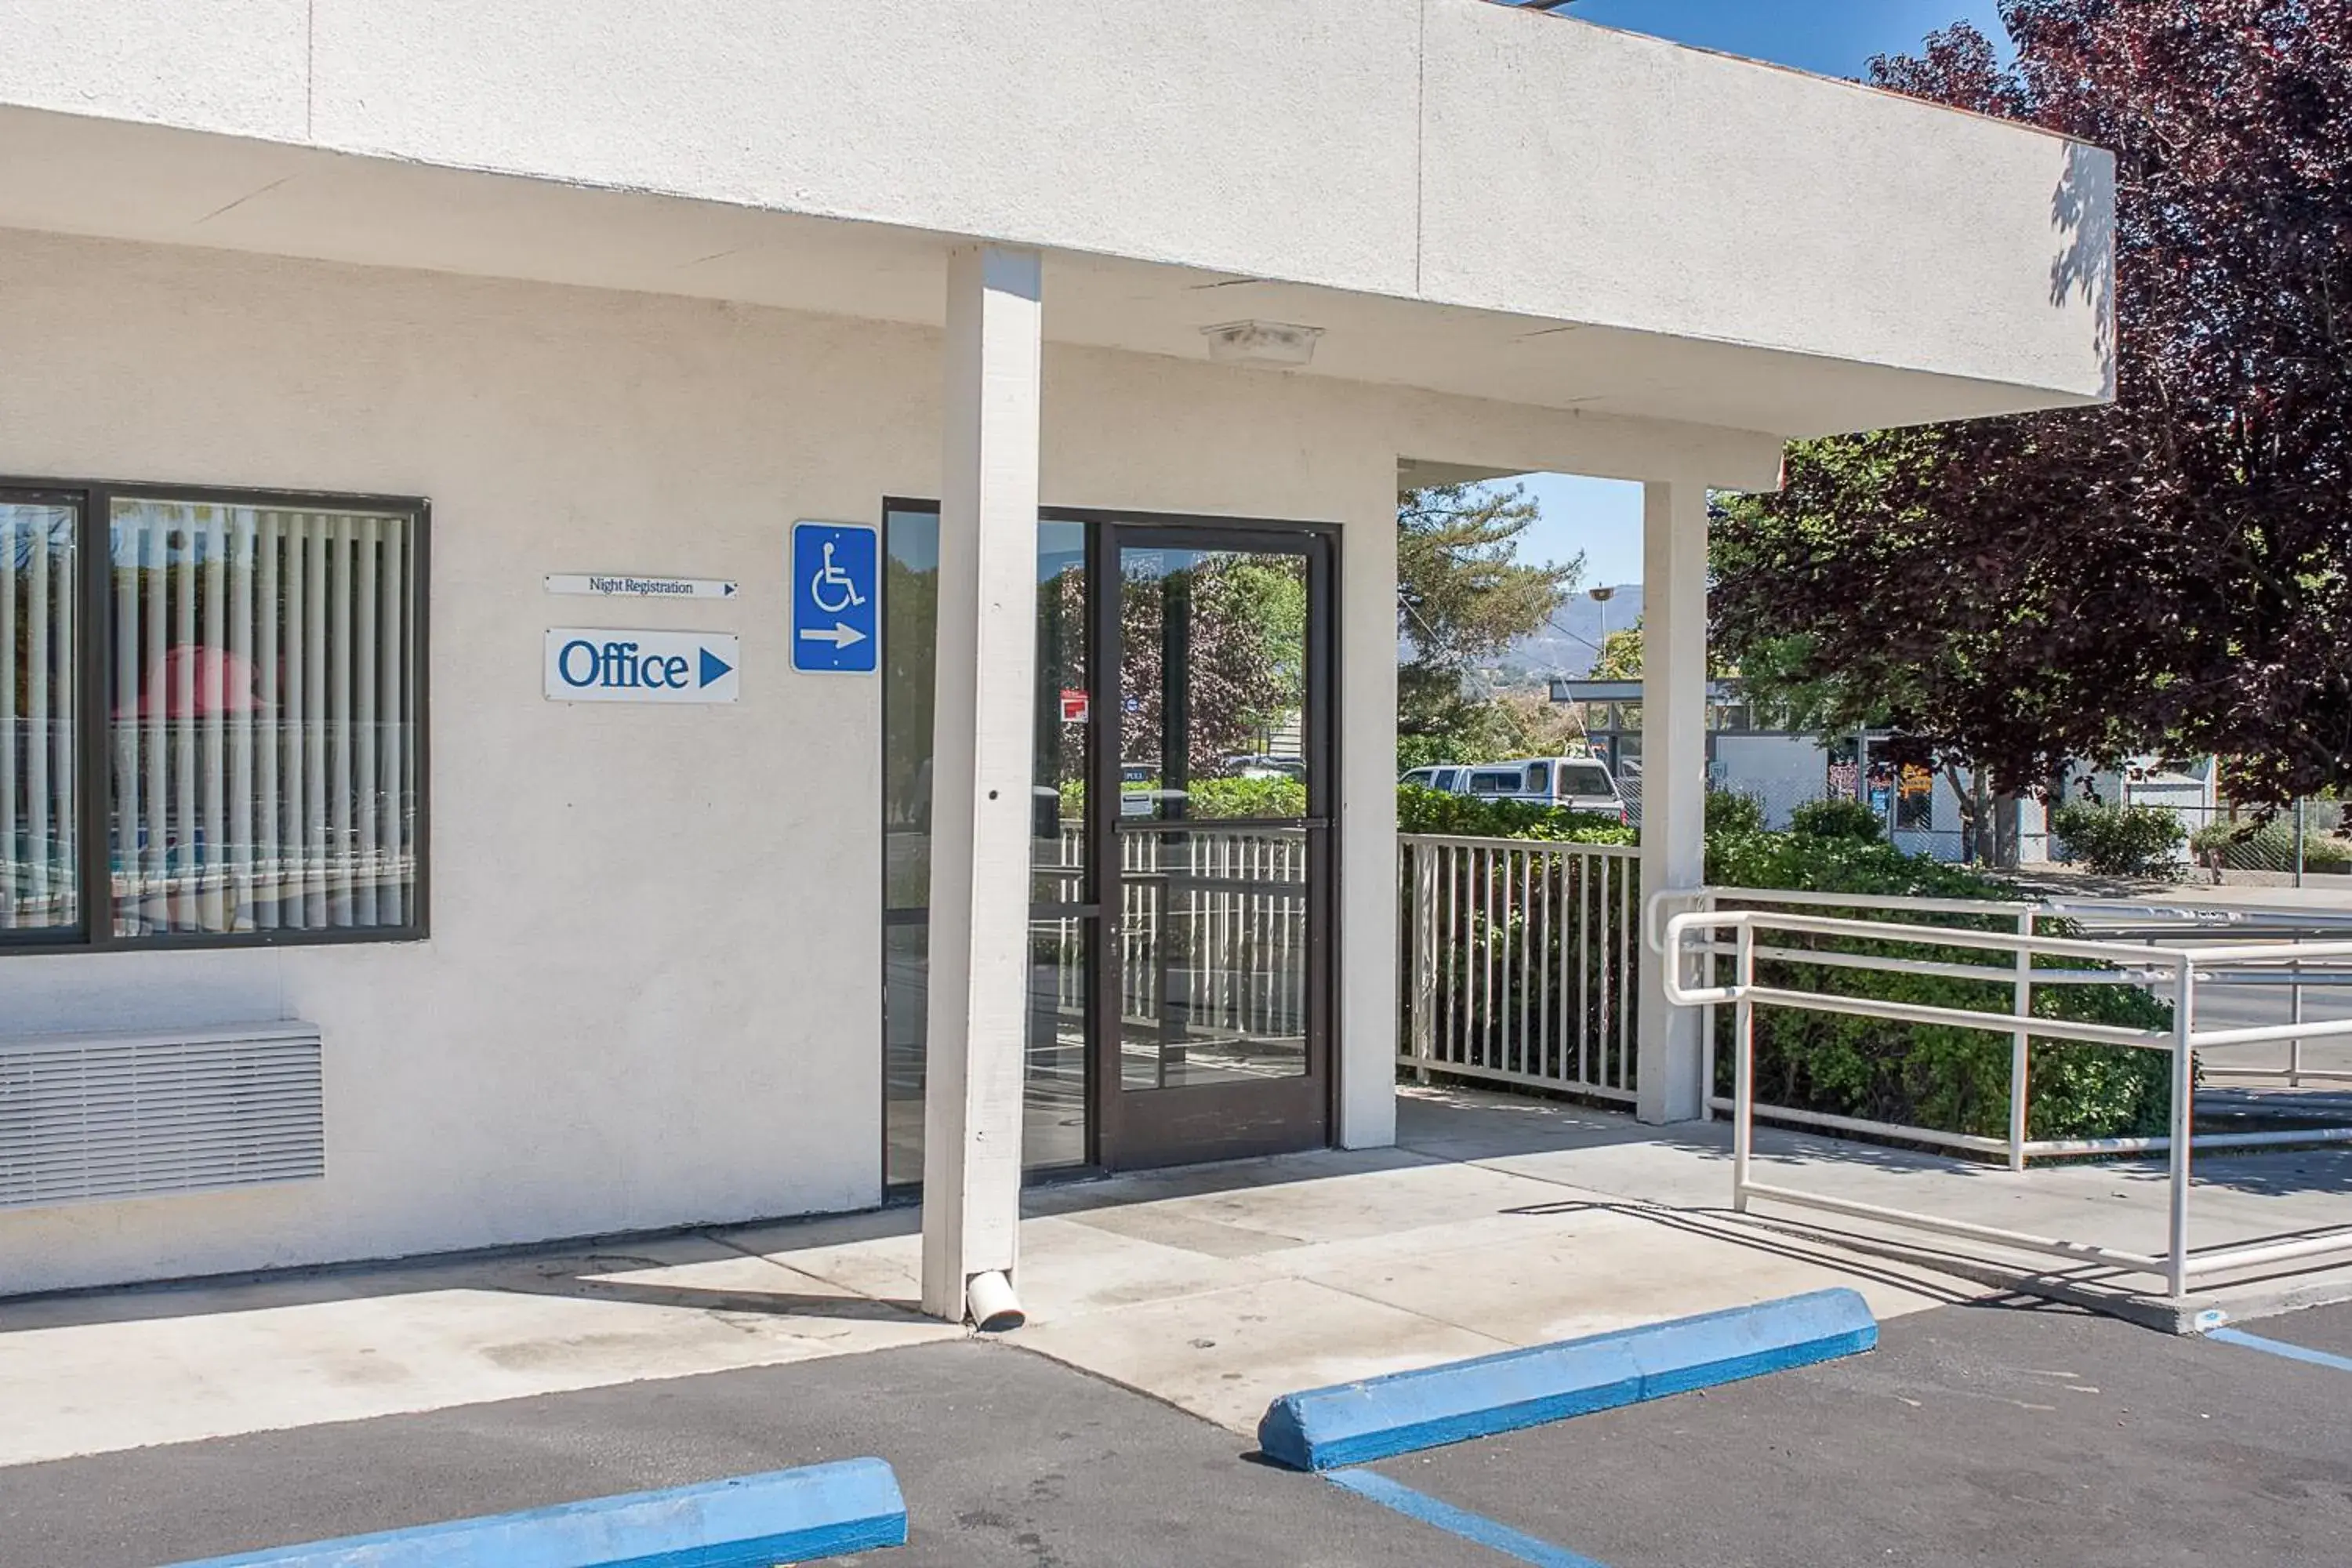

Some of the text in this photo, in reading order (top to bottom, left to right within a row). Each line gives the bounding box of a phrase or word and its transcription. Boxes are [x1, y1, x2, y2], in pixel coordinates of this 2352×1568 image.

[590, 577, 693, 594] Night Registration
[559, 641, 688, 688] Office
